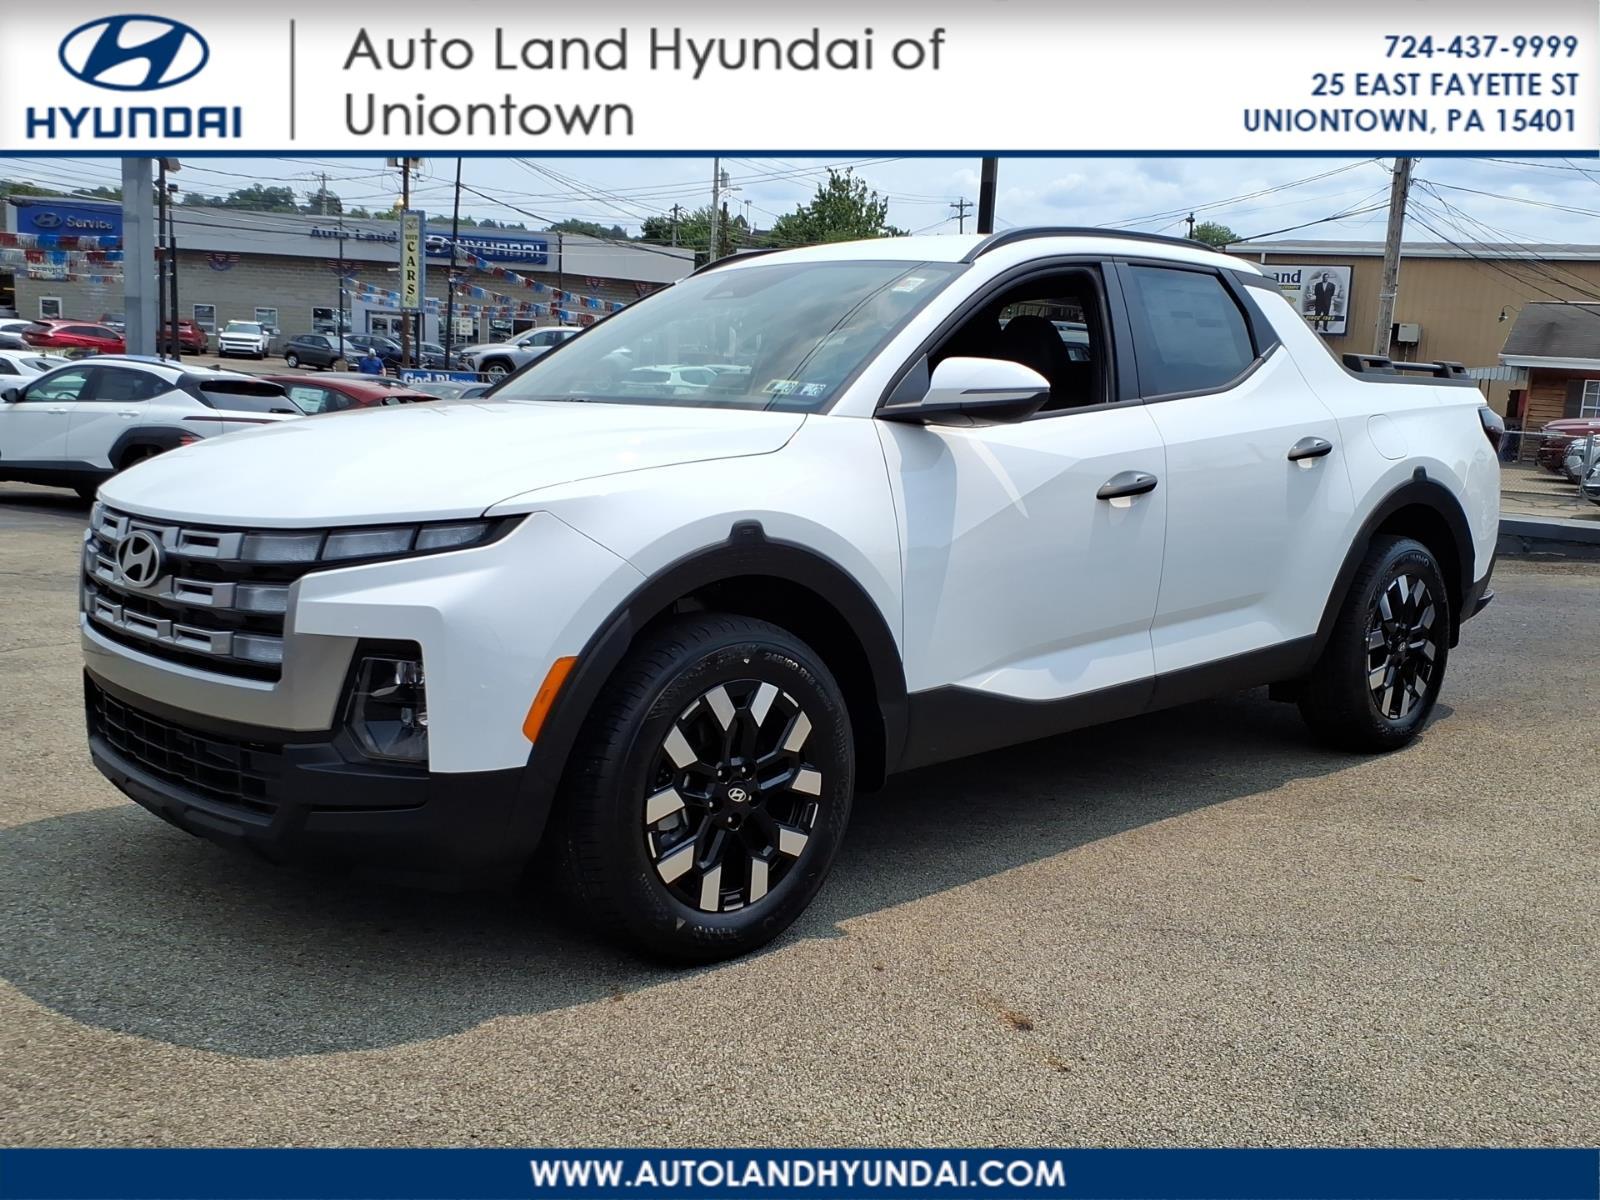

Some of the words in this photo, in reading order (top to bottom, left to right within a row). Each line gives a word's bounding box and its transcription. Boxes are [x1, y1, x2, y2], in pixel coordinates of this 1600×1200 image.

[66, 215, 113, 230] Service
[457, 239, 541, 258] HYUNDAI
[406, 241, 416, 295] CARS
[1273, 269, 1302, 284] and
